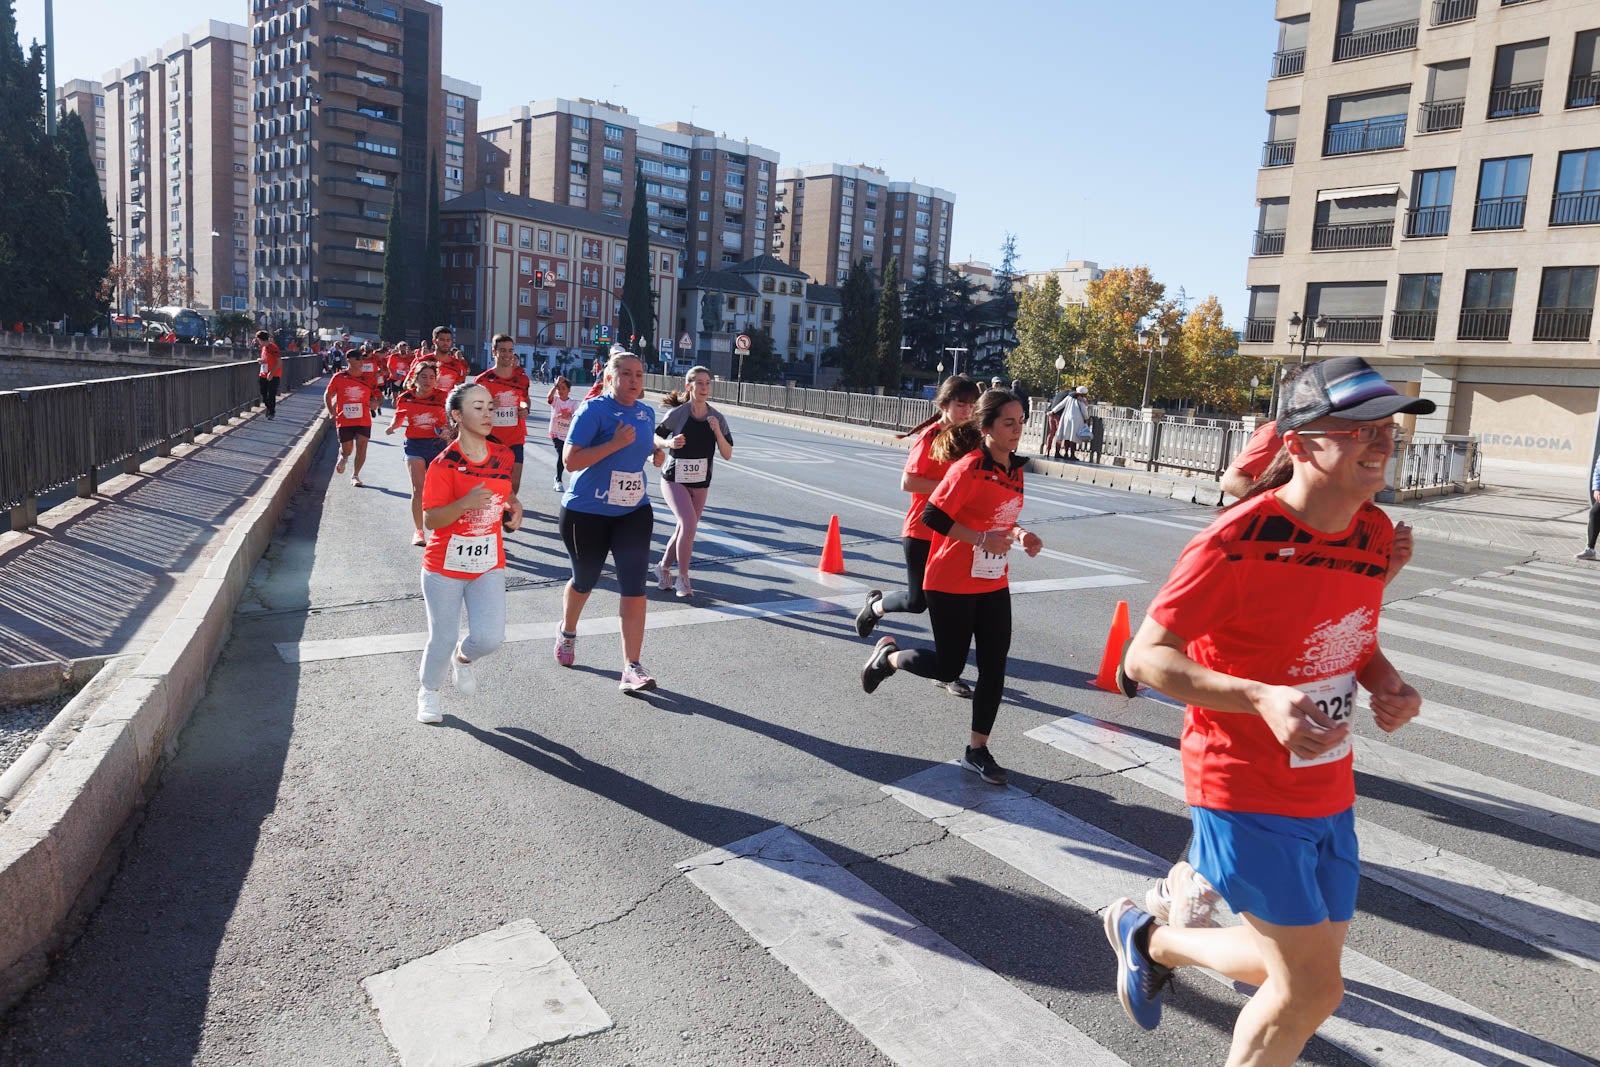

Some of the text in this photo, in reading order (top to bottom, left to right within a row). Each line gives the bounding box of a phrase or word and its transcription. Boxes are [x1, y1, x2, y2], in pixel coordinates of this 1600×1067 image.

[602, 326, 609, 334] P
[683, 464, 700, 472] 330
[618, 480, 642, 491] 1252
[456, 544, 489, 556] 1181
